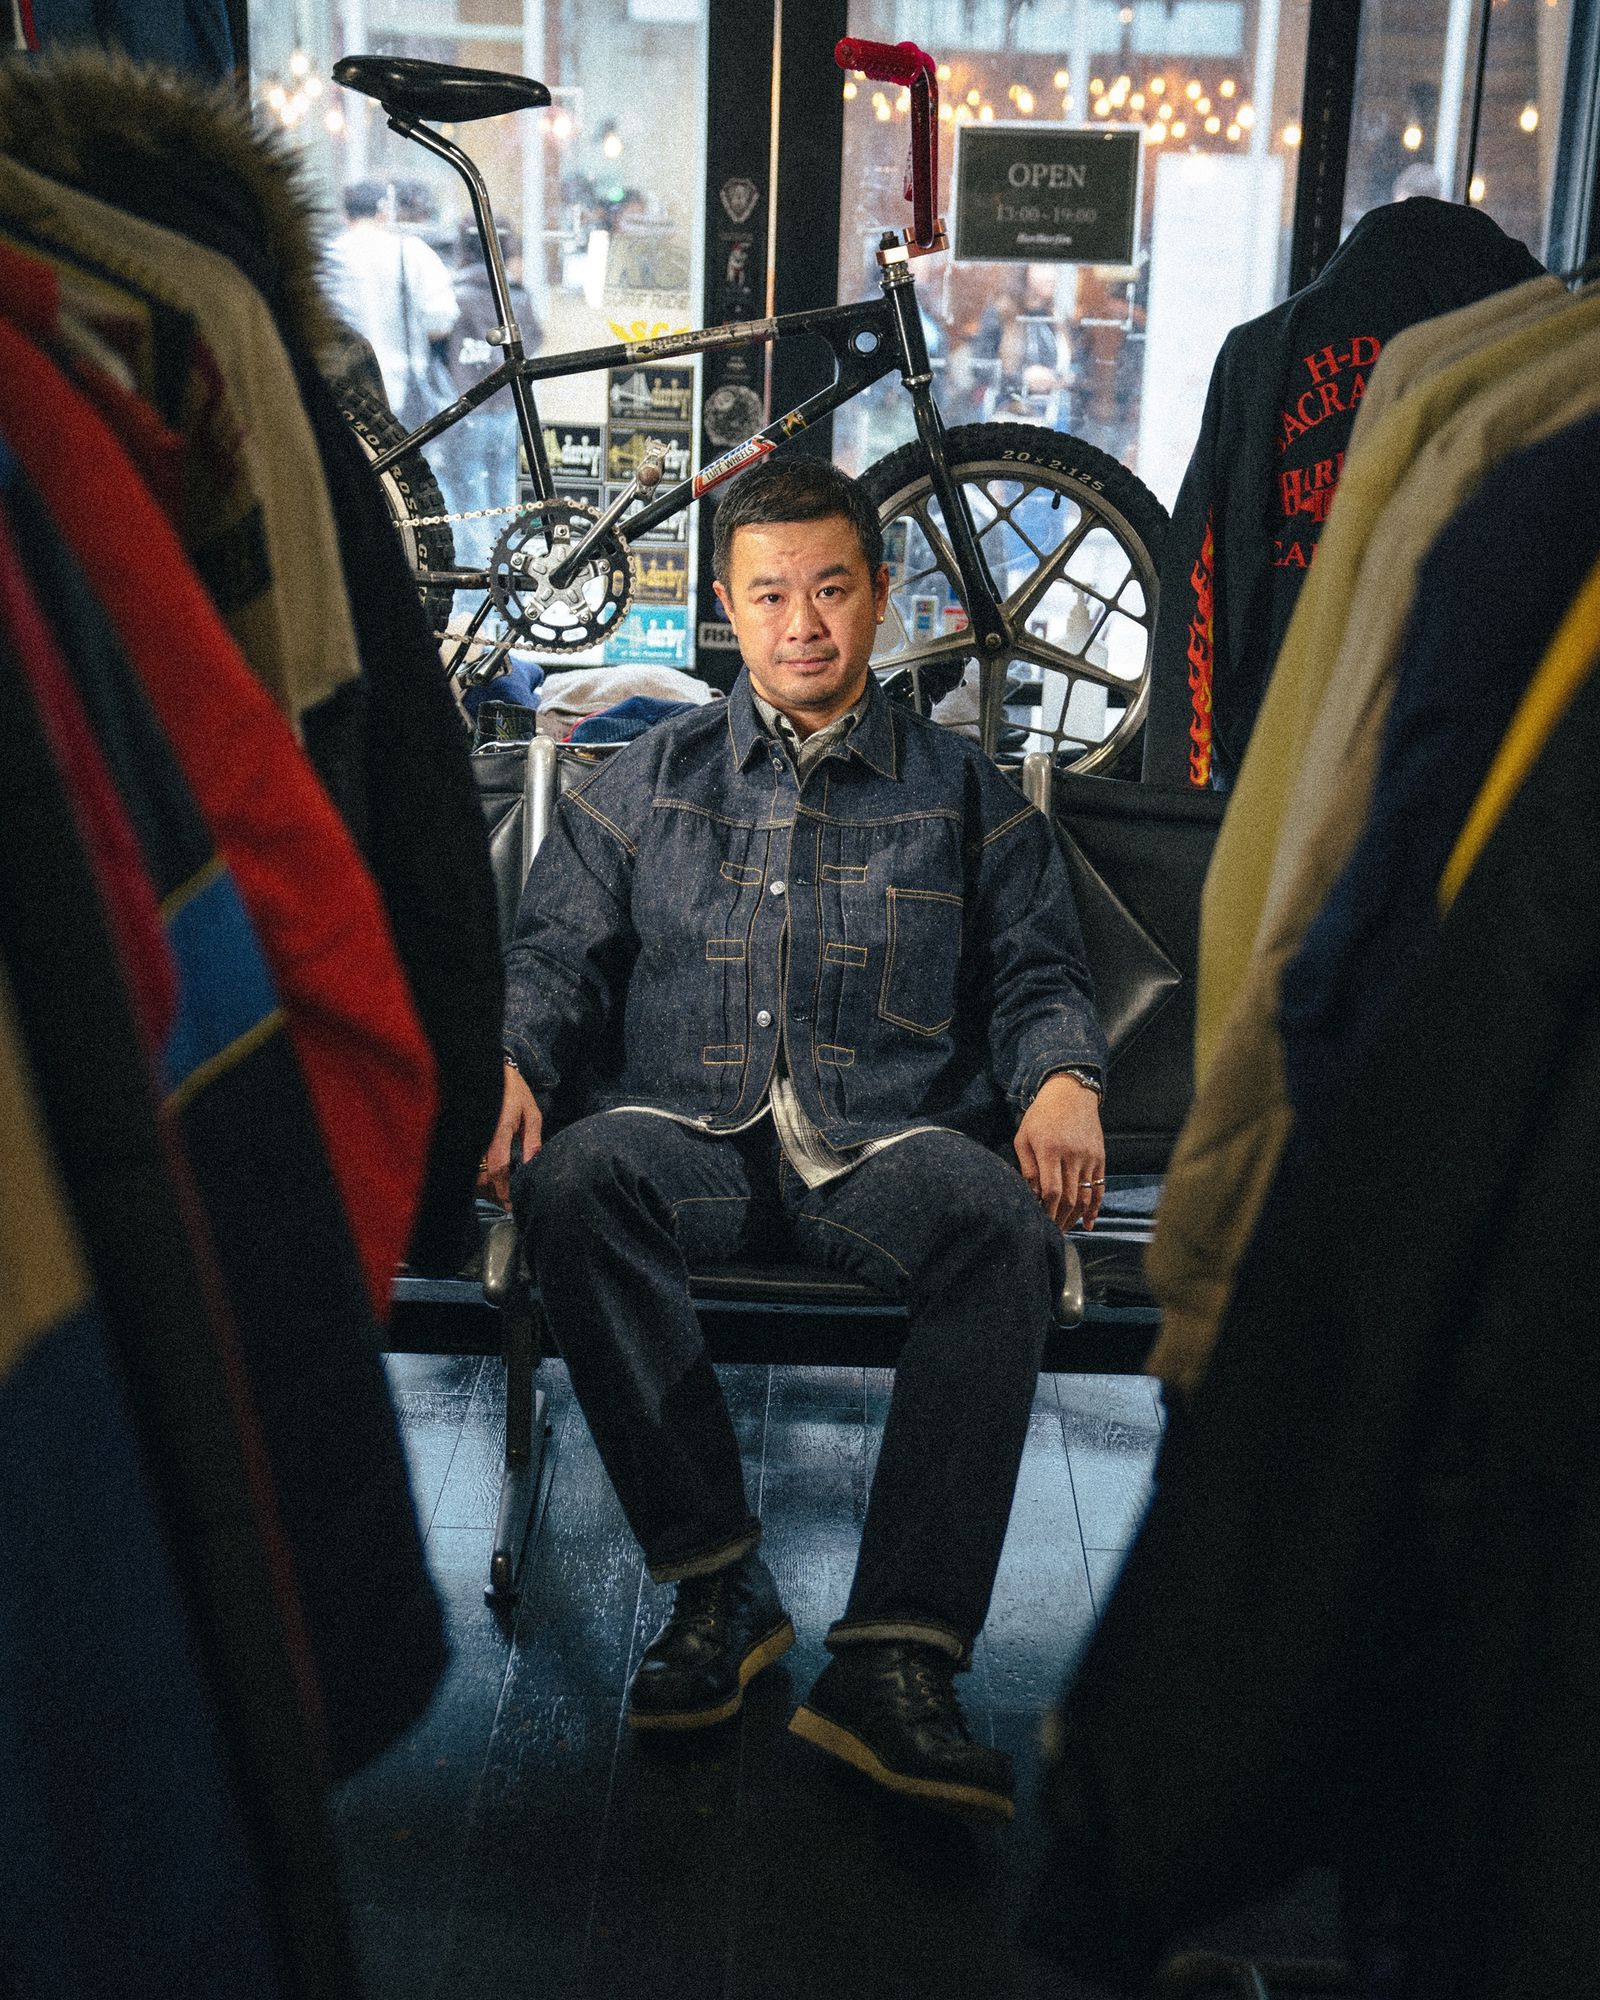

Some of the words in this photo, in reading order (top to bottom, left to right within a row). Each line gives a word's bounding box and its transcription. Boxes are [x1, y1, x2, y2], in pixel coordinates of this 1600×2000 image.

[1008, 163, 1087, 188] OPEN
[1281, 372, 1367, 453] ACRA
[705, 466, 724, 481] TUFF
[724, 445, 755, 470] WHEELS
